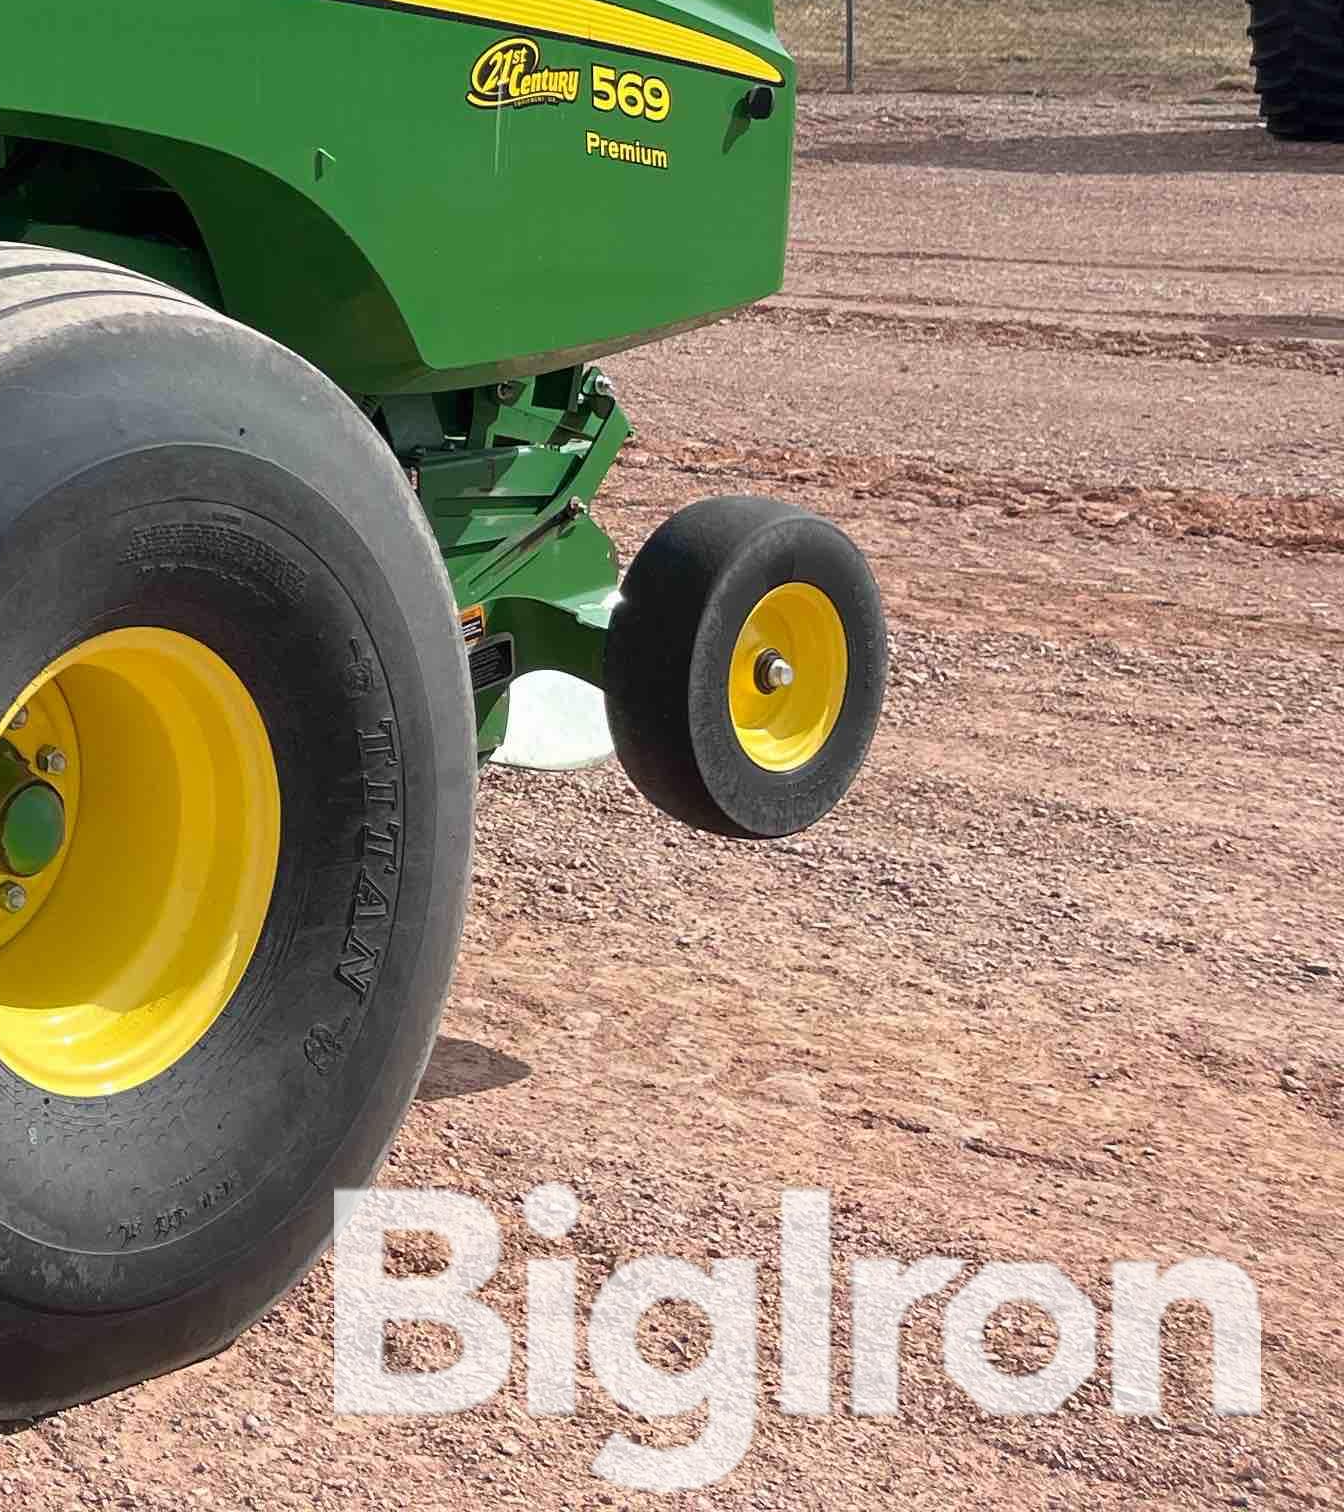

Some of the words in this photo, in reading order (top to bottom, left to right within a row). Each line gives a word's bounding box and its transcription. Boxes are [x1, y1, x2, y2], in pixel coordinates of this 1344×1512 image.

[592, 65, 671, 121] 569
[586, 131, 668, 168] Premium
[335, 714, 400, 1005] TITAN
